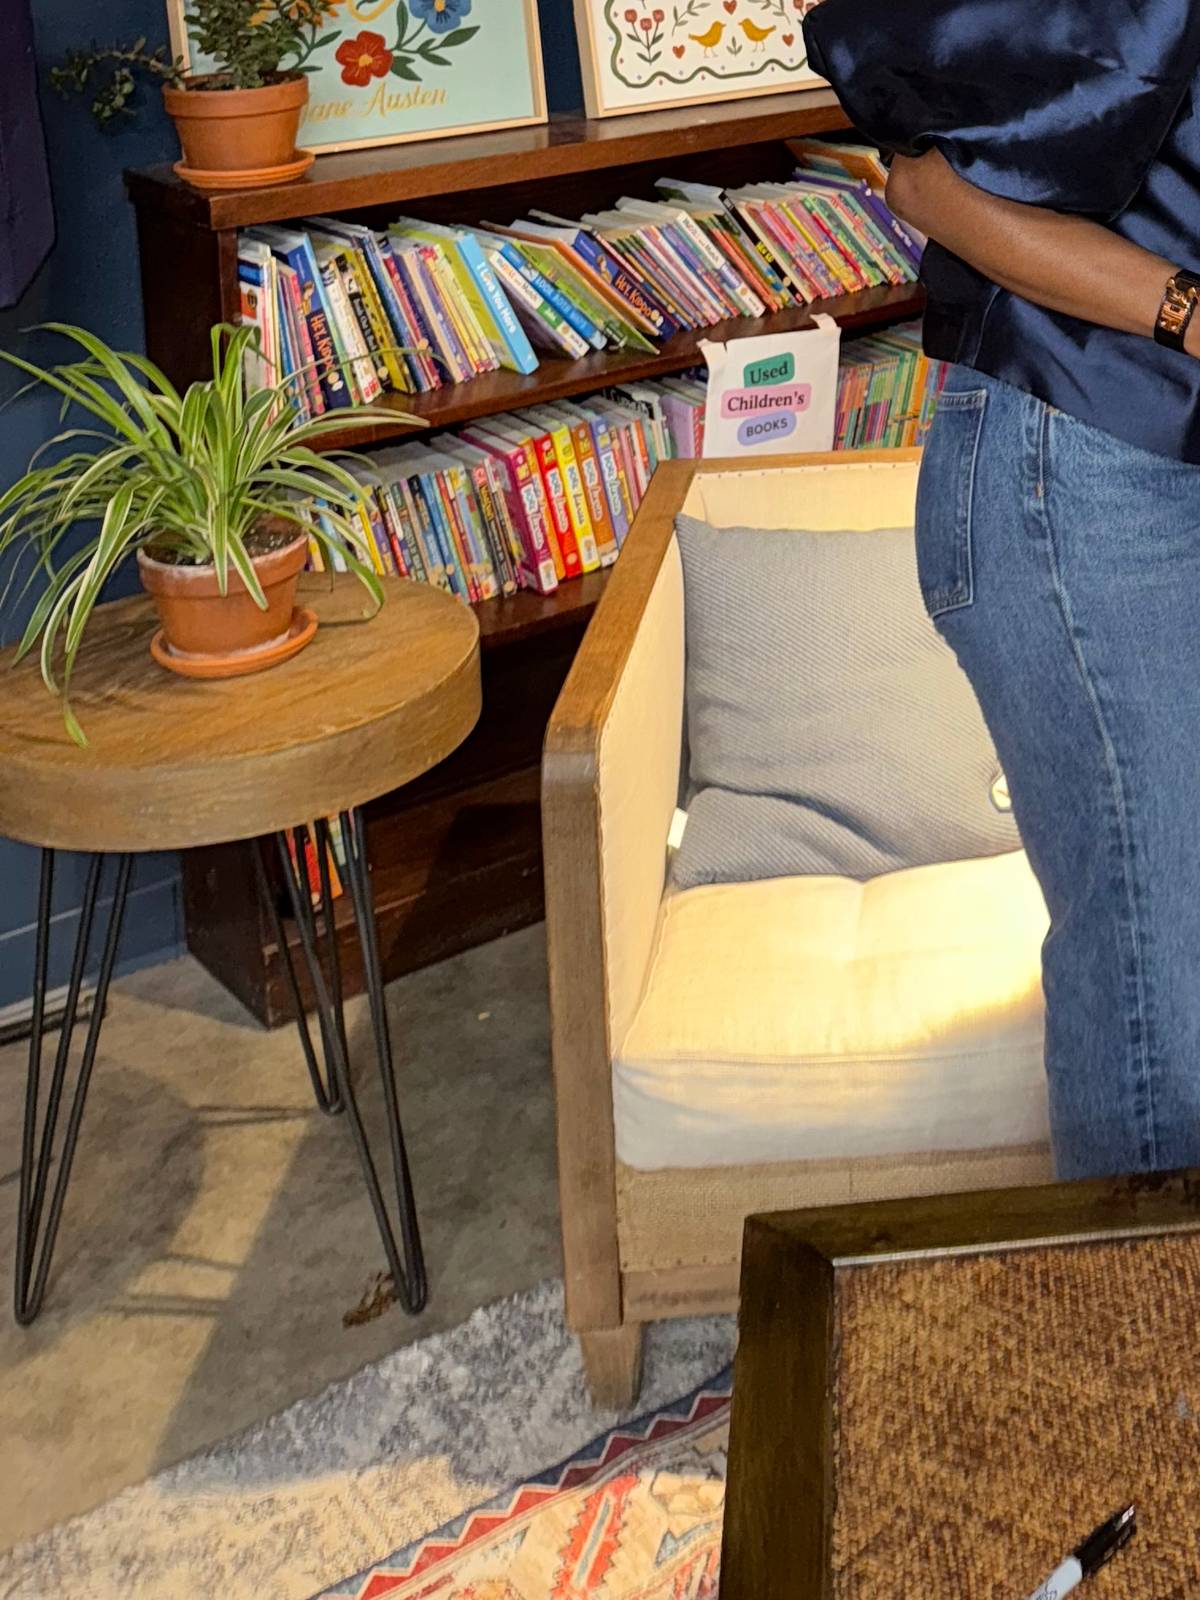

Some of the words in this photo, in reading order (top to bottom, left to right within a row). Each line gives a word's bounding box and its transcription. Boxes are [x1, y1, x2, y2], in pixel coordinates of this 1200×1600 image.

[361, 80, 447, 118] Austen
[480, 268, 495, 293] Love
[493, 291, 505, 312] You
[750, 365, 788, 384] Used
[727, 391, 805, 413] Children's
[746, 418, 788, 438] BOOKS
